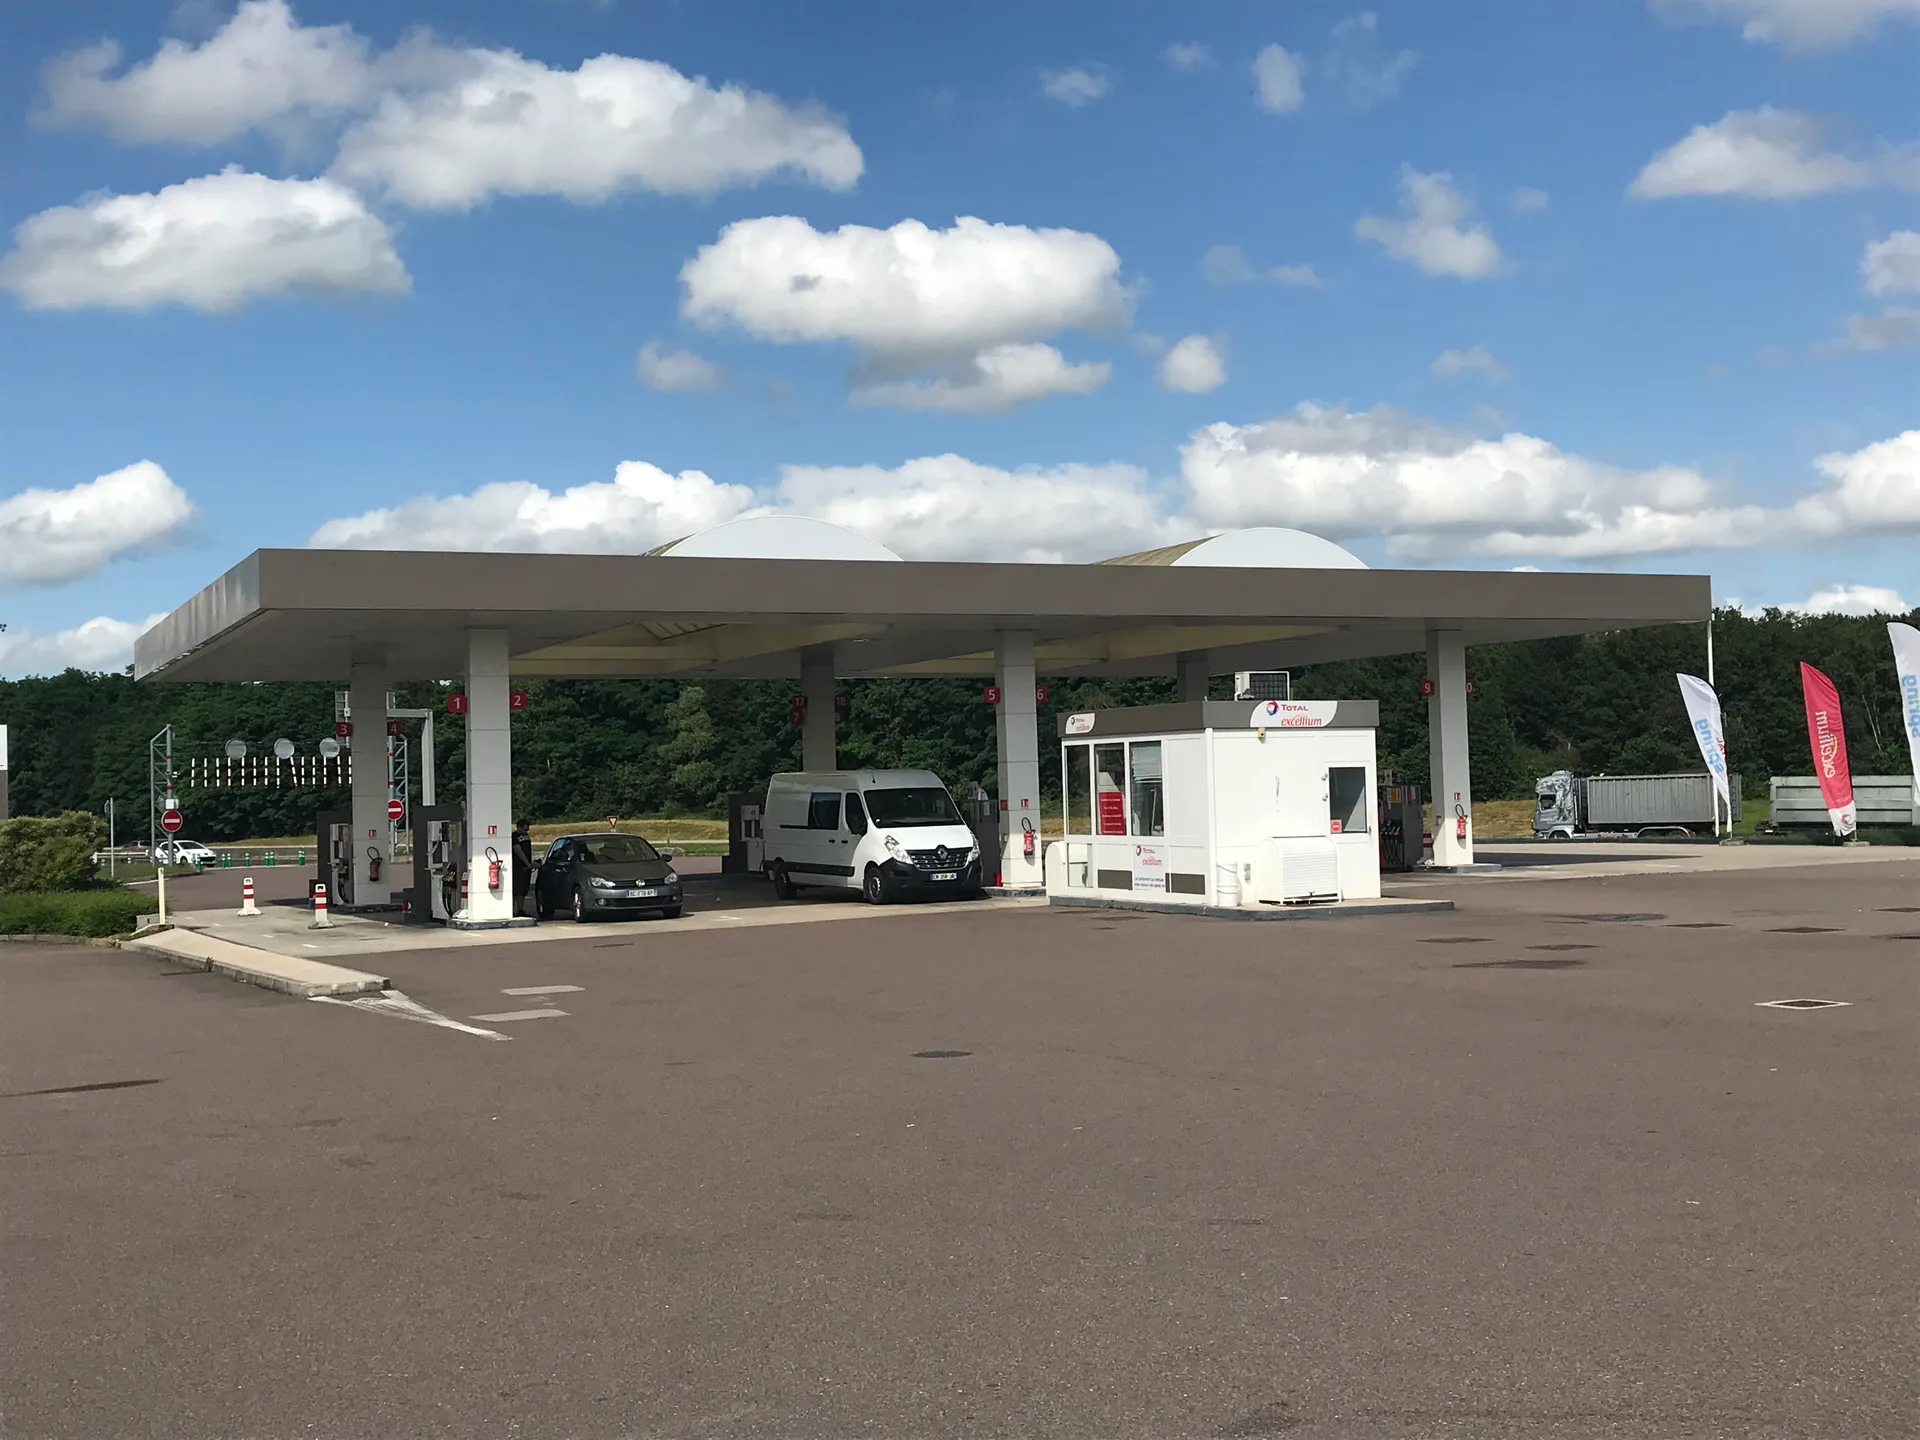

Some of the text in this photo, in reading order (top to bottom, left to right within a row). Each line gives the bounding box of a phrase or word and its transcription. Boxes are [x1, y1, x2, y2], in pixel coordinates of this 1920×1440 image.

[1424, 682, 1431, 693] 9
[988, 689, 996, 701] 5
[1036, 688, 1044, 700] 6
[453, 697, 461, 710] 1
[513, 695, 521, 706] 2
[1281, 715, 1322, 726] excellium
[340, 724, 348, 735] 3
[390, 723, 397, 734] 4
